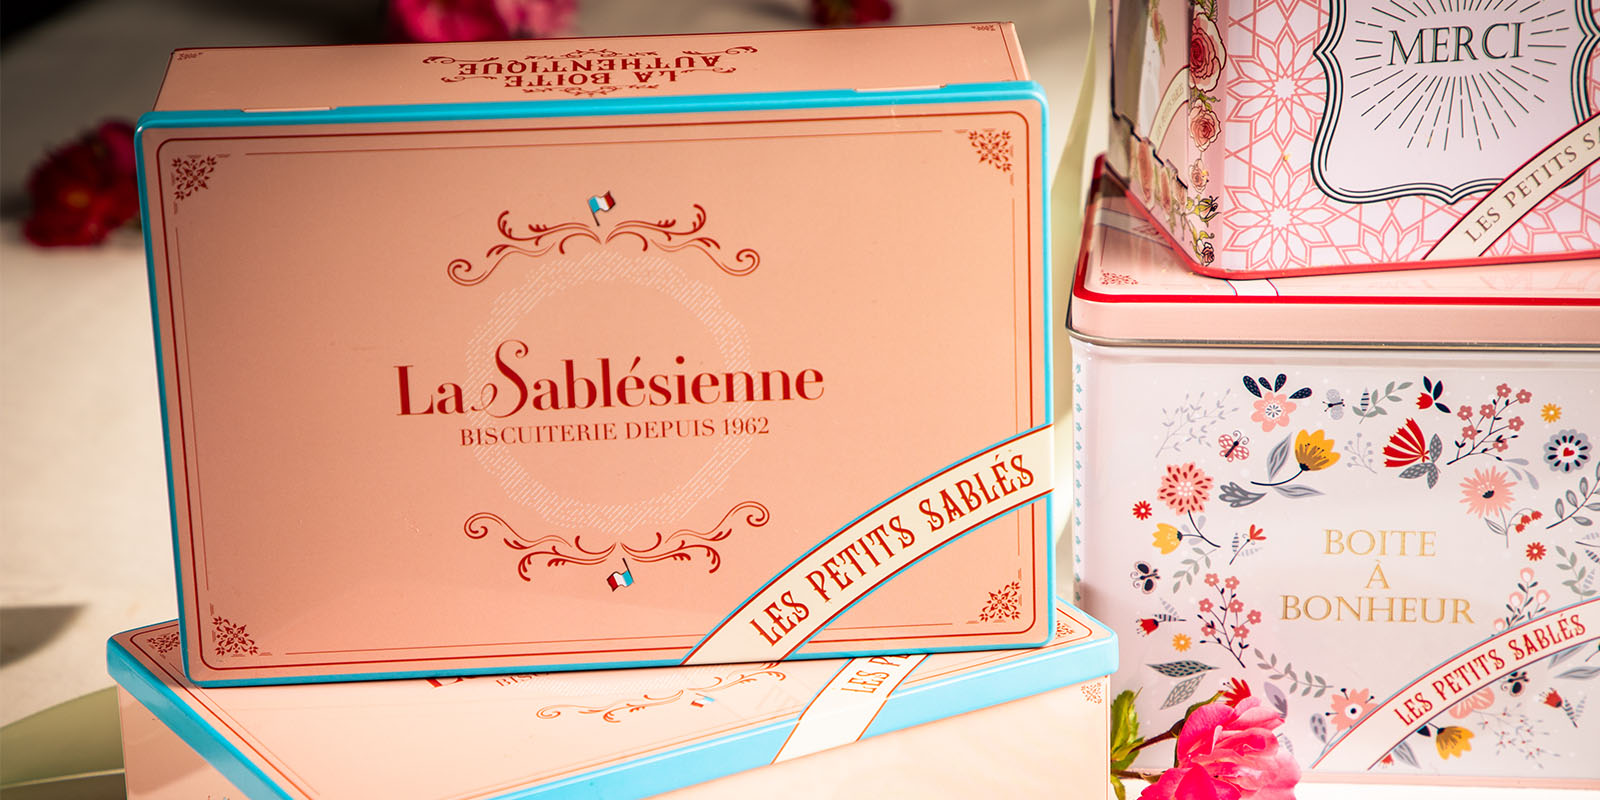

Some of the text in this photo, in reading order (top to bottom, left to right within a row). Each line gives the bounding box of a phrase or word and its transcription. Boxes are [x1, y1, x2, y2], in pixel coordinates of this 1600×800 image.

[1387, 21, 1527, 66] MERCI
[458, 55, 721, 76] AUTHENTIQUE
[504, 71, 677, 88] LA BOITE
[1464, 206, 1501, 243] LES
[1503, 145, 1577, 209] PETITS
[393, 339, 825, 418] La Sablésienne
[460, 416, 769, 447] BISCUITERIE DEPUIS 1962
[749, 453, 1035, 647] LES PETITS SABLÉS
[1324, 529, 1436, 557] BOITE
[1364, 559, 1391, 589] À
[1280, 595, 1474, 624] BONHEUR
[840, 669, 890, 694] LES
[1393, 612, 1587, 727] LES PETITS SABLÉS
